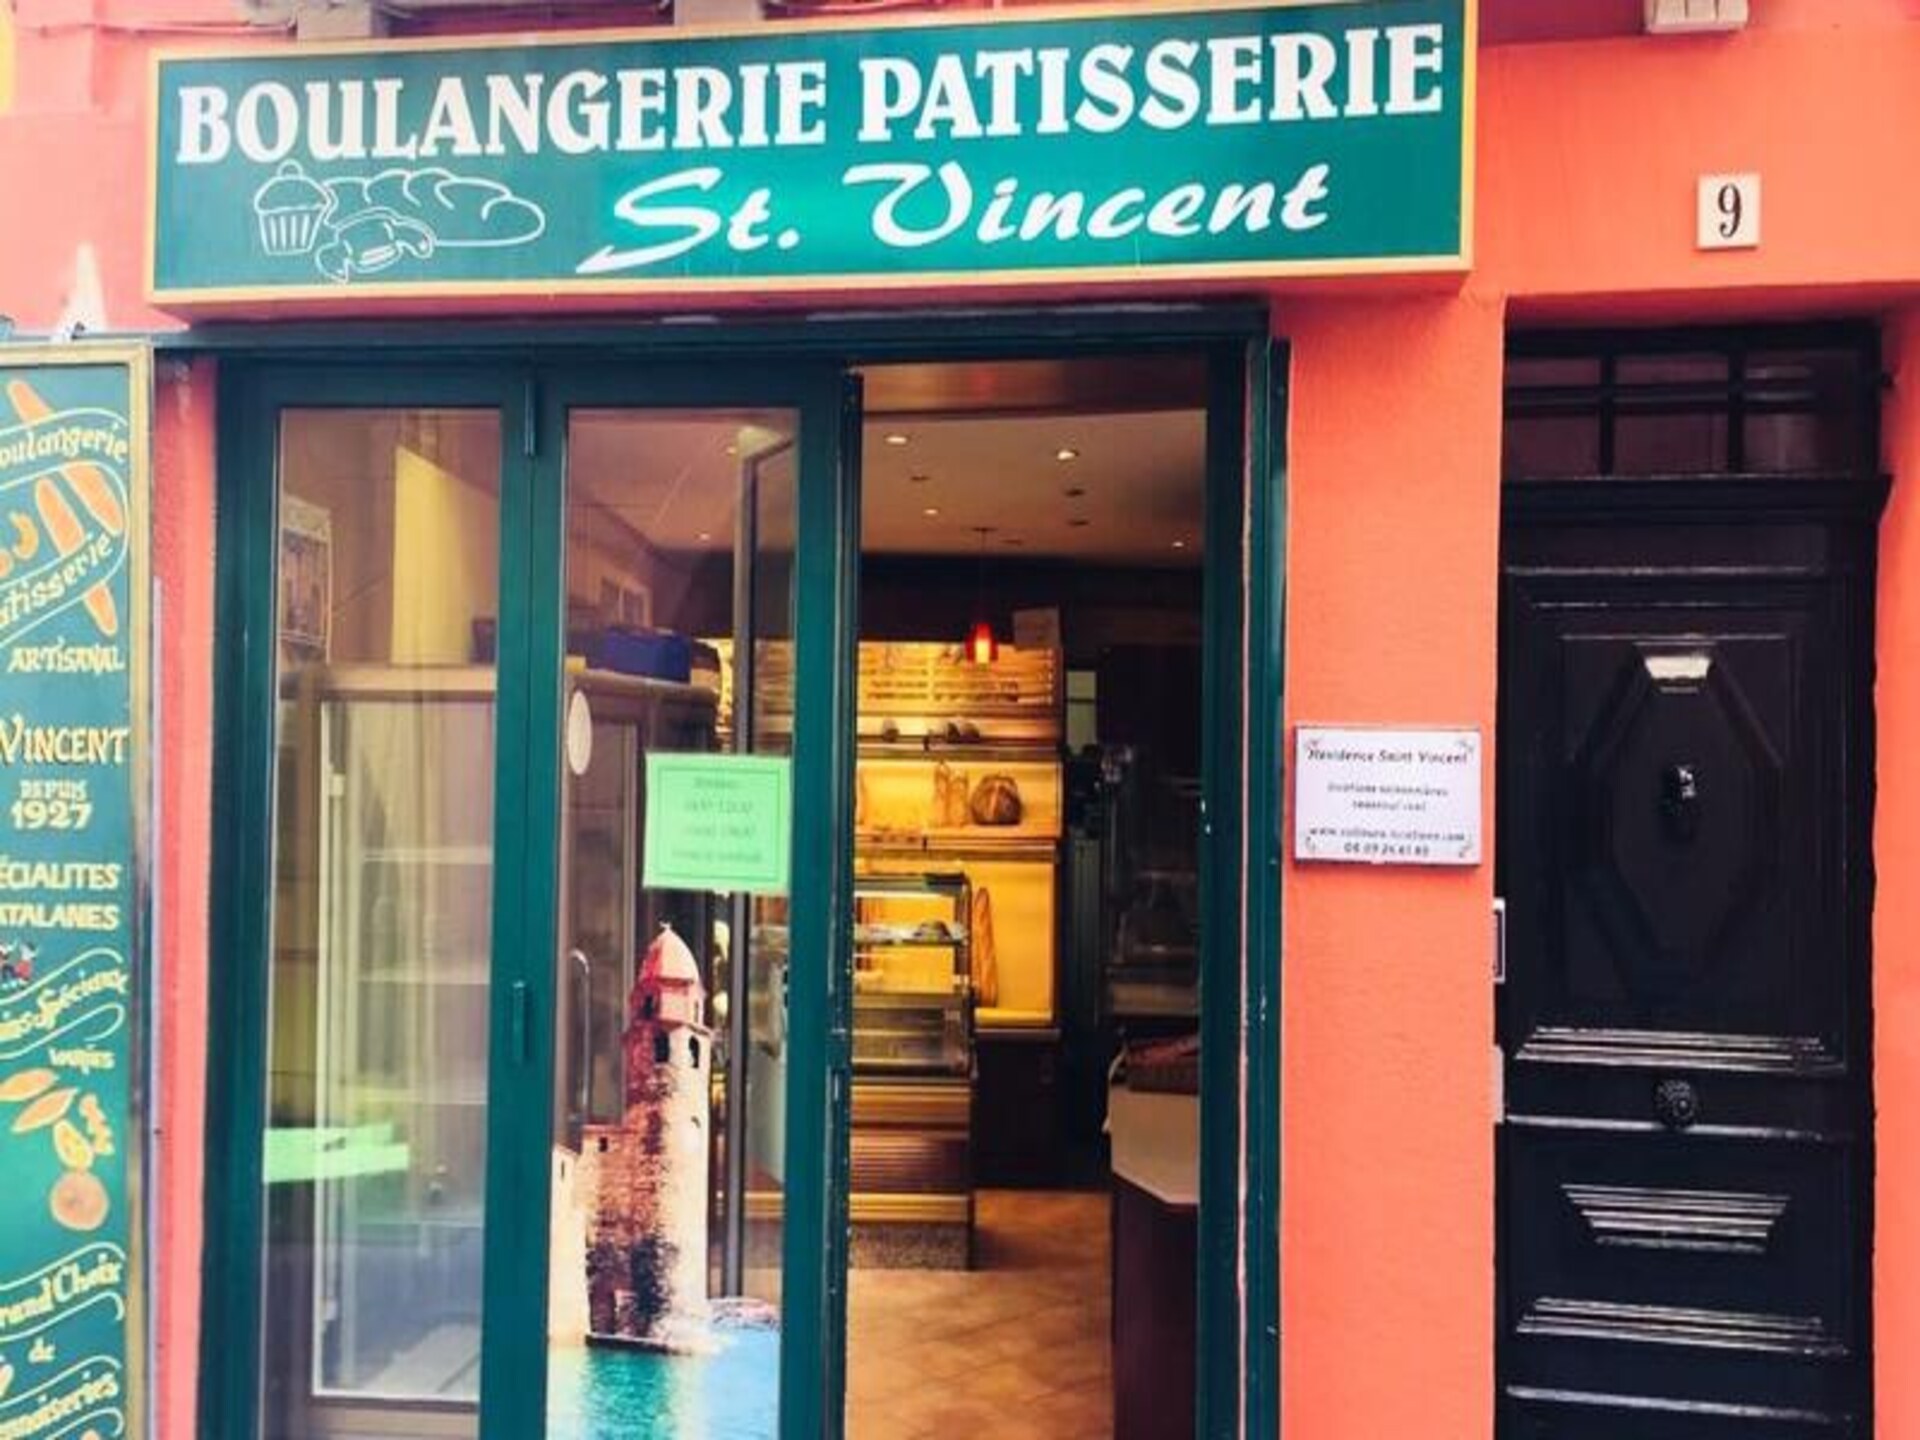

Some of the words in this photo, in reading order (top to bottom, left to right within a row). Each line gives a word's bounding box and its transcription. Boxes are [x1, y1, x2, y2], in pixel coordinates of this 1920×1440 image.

[176, 61, 826, 163] BOULANGERIE
[857, 24, 1443, 142] PATISSERIE
[575, 167, 799, 273] St.
[842, 161, 1331, 247] Vincent
[1718, 183, 1742, 238] 9
[0, 713, 129, 764] VINCENT
[1378, 750, 1412, 764] Saint
[1418, 752, 1467, 766] Vincent
[11, 800, 92, 829] 1927
